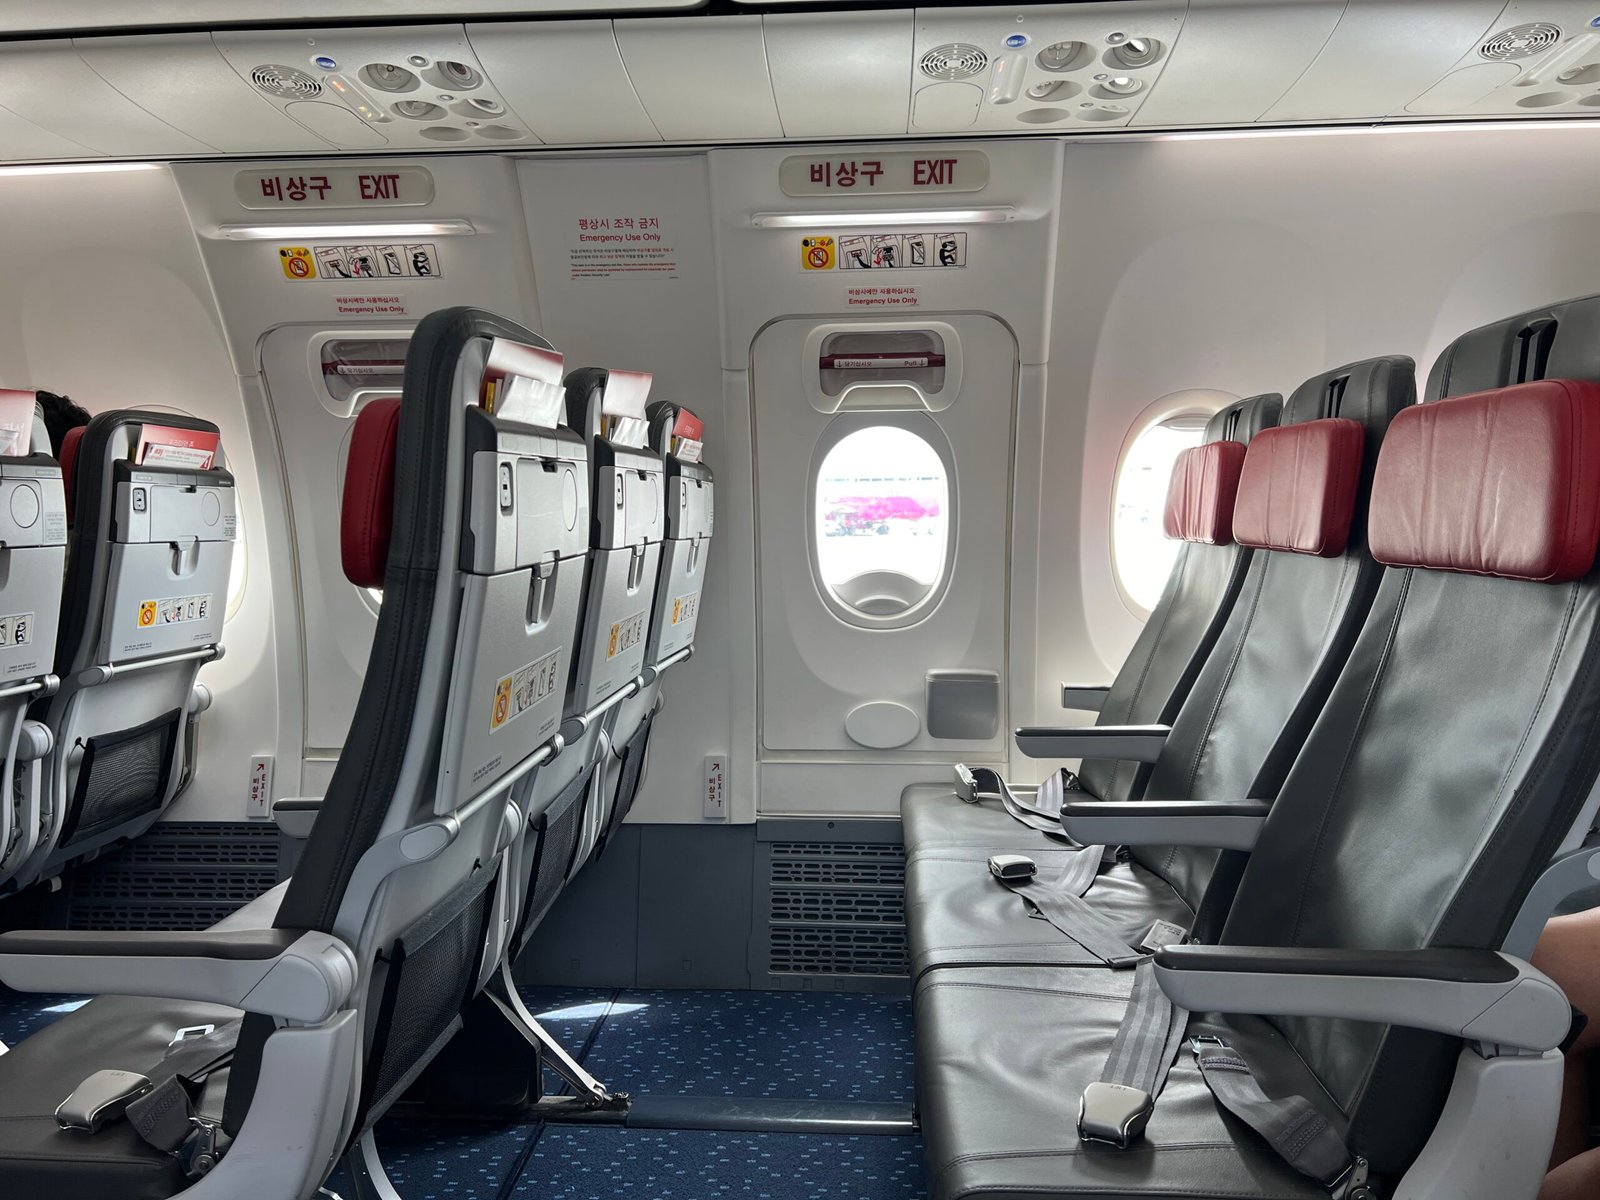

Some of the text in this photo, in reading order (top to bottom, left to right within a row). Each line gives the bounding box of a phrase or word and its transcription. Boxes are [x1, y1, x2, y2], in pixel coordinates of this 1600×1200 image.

[810, 159, 957, 187] 비상구 EXIT
[261, 174, 400, 201] 비상구 EXIT
[578, 217, 659, 230] 평상시 조작 금지
[579, 232, 661, 242] Emergency Use Only
[901, 296, 918, 305] Only
[338, 306, 374, 314] Emergency
